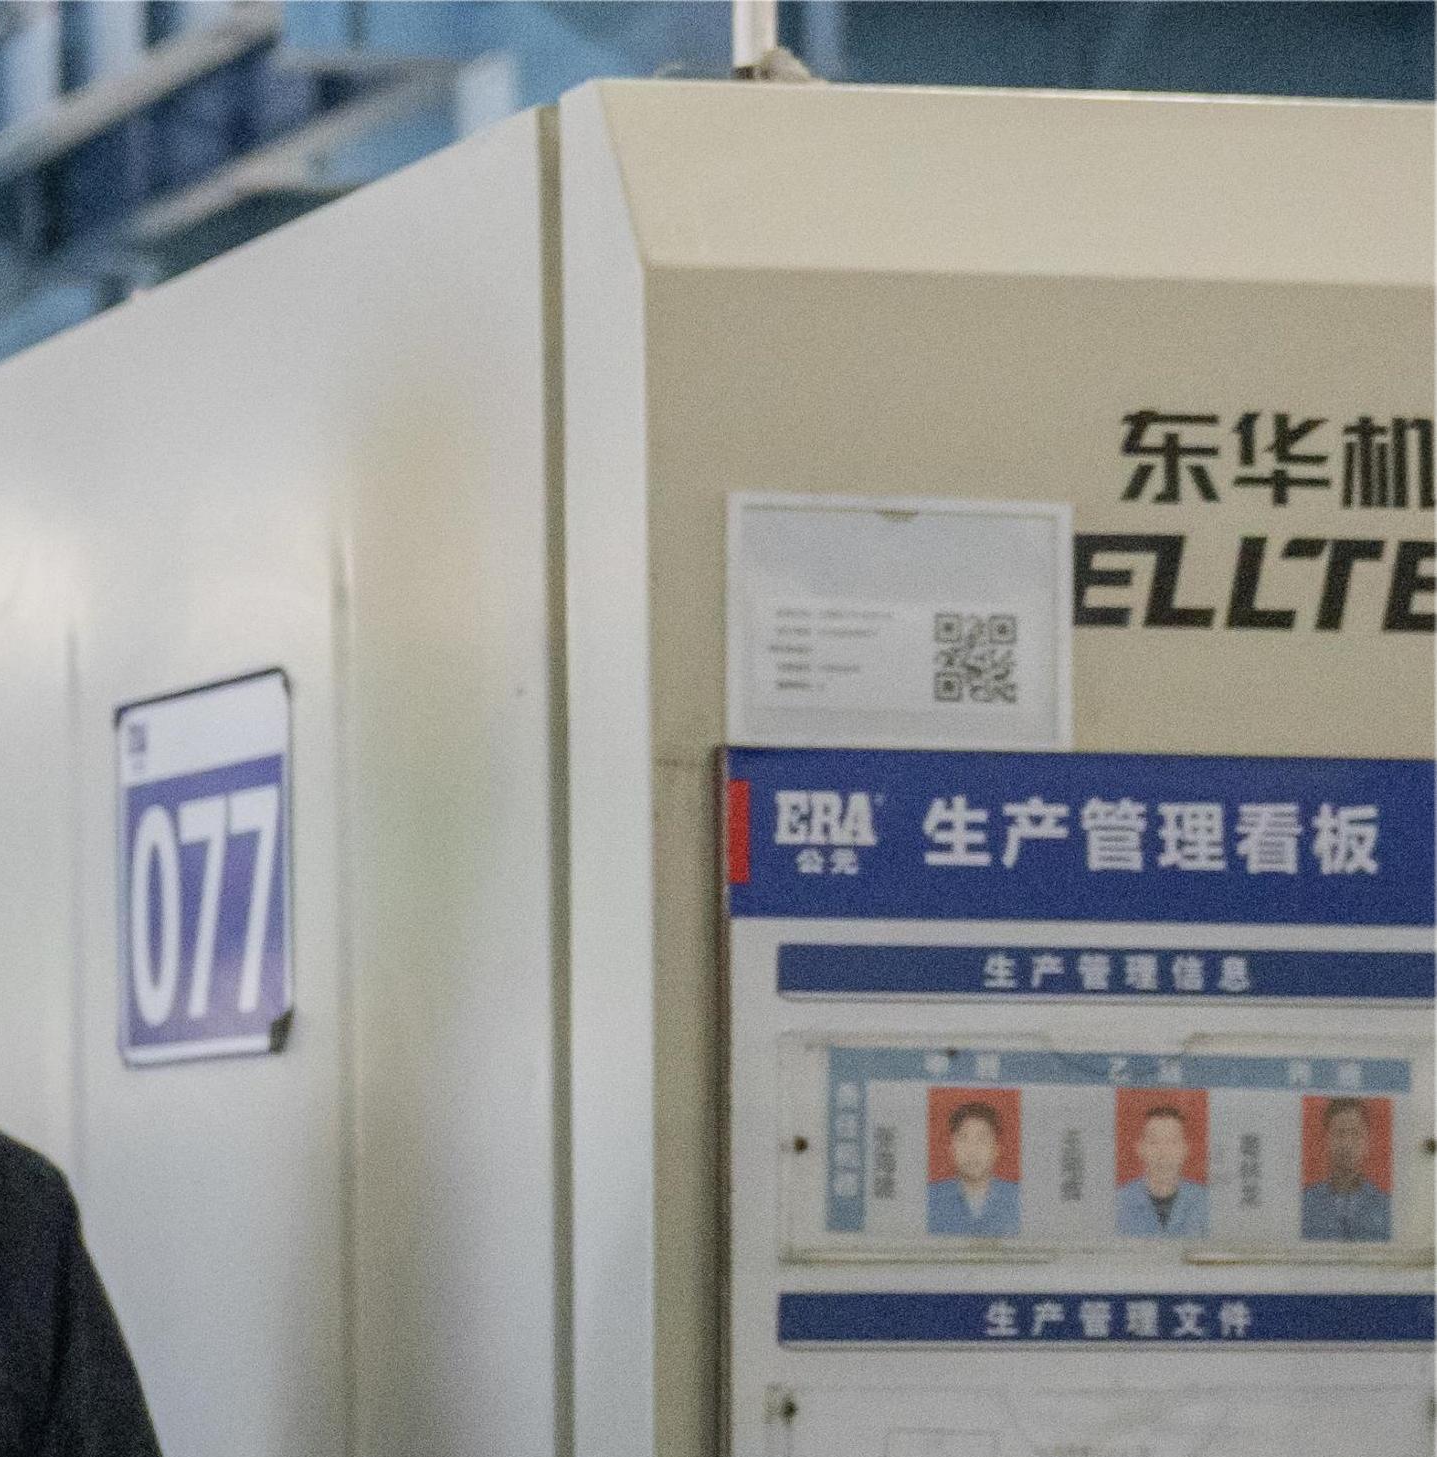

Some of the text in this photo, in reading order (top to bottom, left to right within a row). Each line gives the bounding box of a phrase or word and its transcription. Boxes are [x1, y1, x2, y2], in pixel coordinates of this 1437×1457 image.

[1121, 409, 1435, 510] 东华机
[775, 790, 877, 846] ERA
[922, 794, 1380, 875] 生产管理看板
[130, 784, 282, 1027] 077
[983, 954, 1251, 992] 生产管理信息
[984, 1299, 1251, 1337] 生产管理文件
